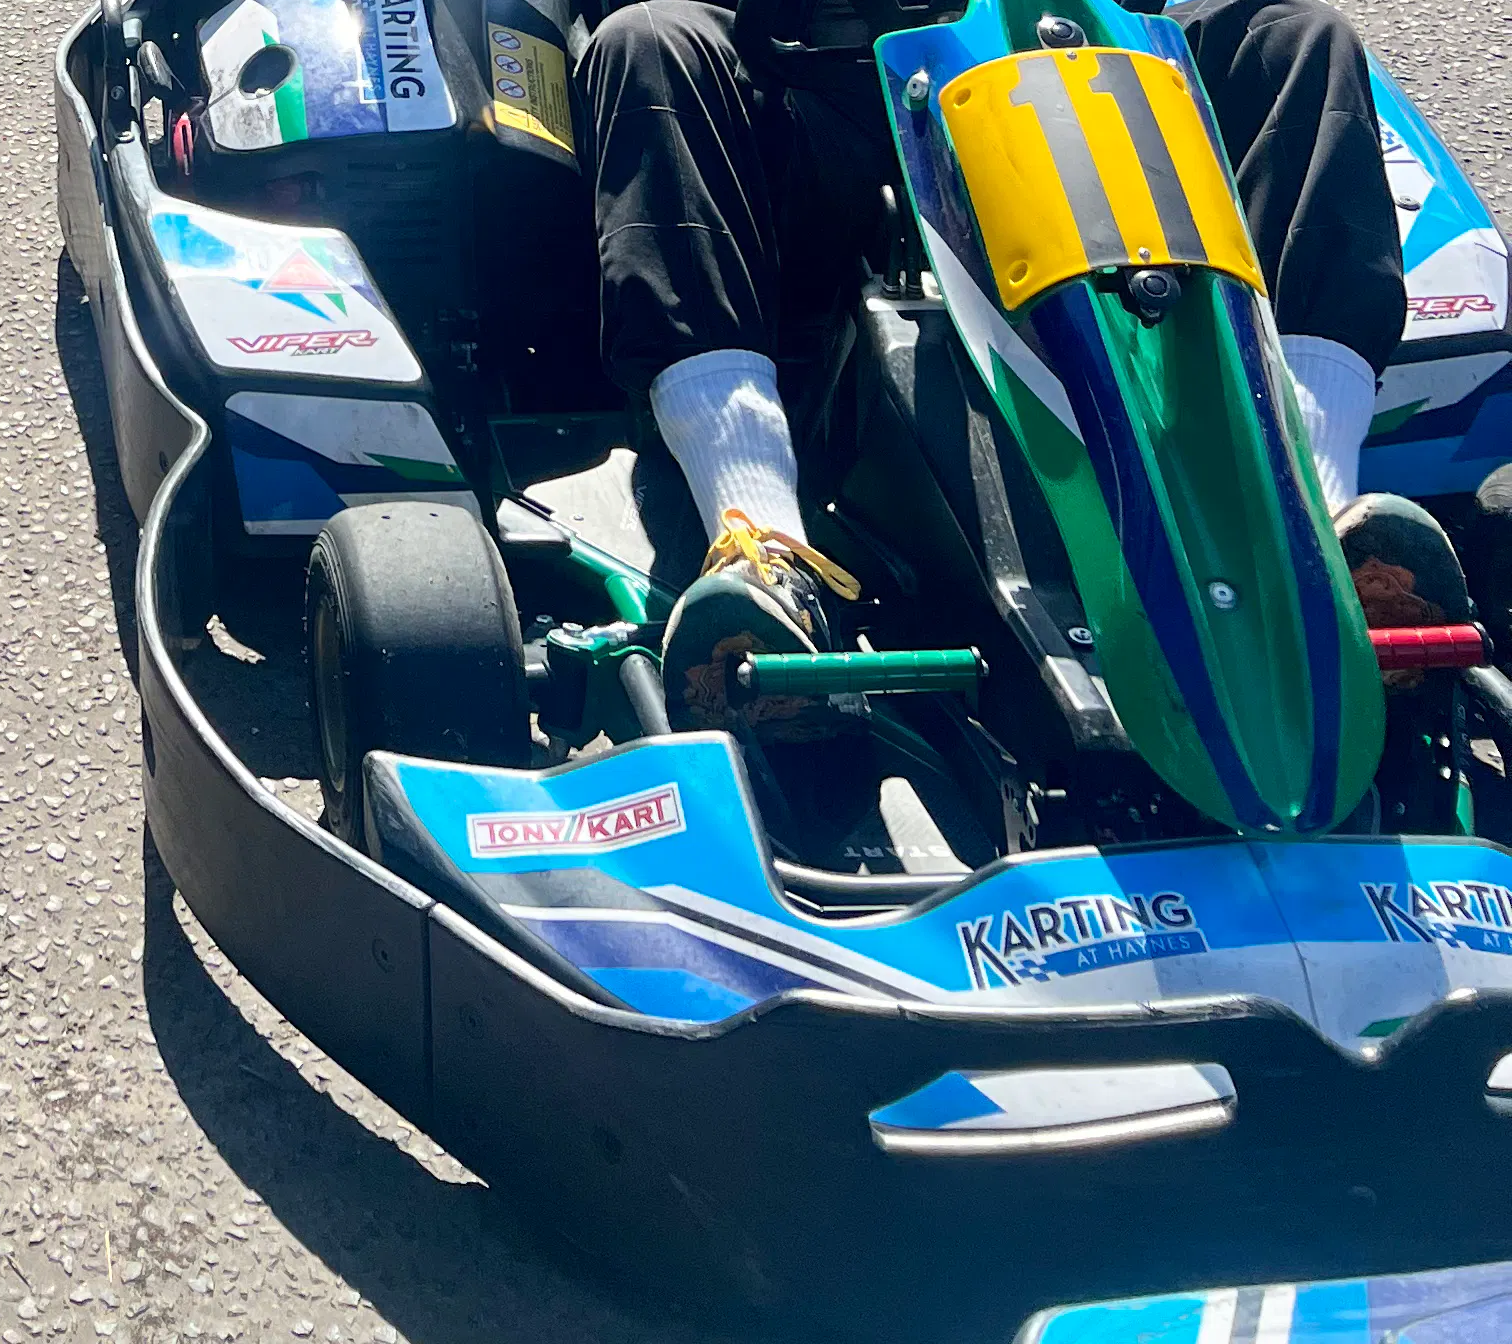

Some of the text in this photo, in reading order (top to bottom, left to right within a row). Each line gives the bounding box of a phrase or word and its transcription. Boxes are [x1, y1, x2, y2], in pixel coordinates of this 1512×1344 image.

[1008, 53, 1209, 268] 11
[1407, 294, 1497, 312] PER
[226, 330, 379, 354] VIPER
[1364, 883, 1512, 943] KARTI
[961, 893, 1193, 990] KARTING
[1077, 935, 1192, 968] AT HAYNES
